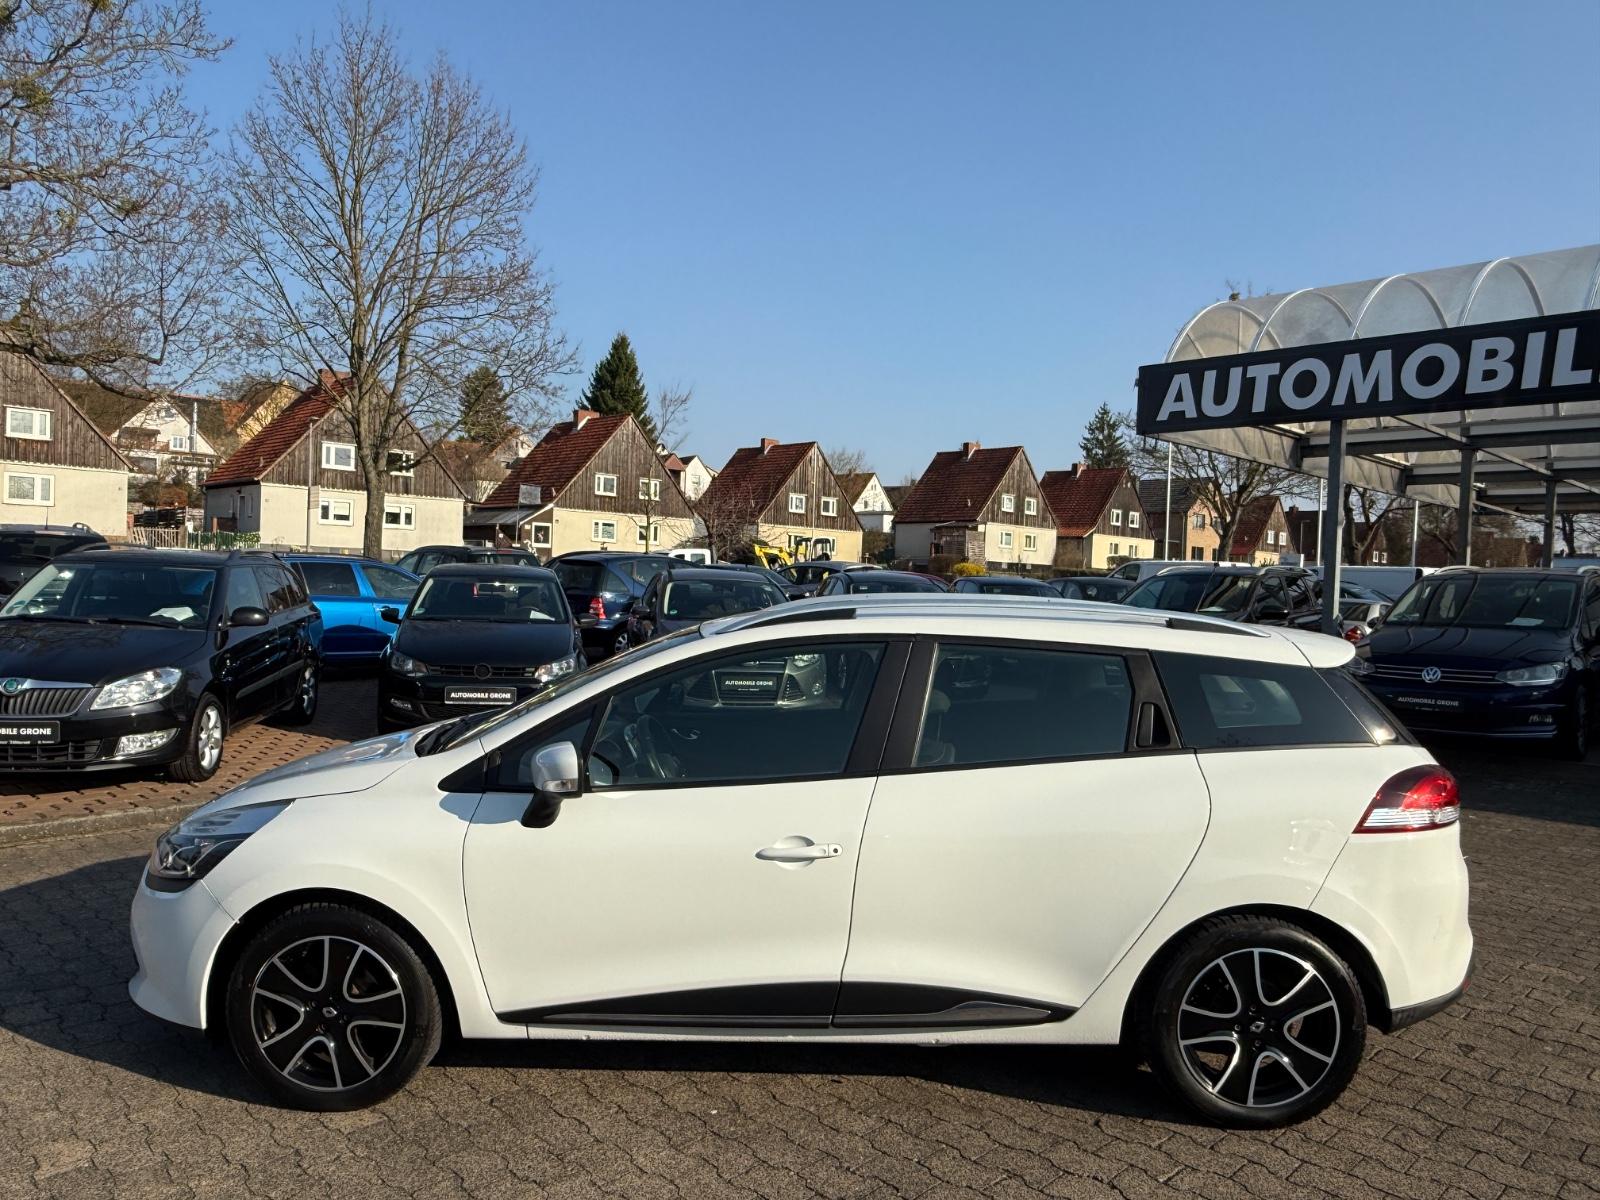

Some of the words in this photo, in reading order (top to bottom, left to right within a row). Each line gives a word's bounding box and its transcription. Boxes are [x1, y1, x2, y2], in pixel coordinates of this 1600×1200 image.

[1155, 327, 1600, 422] AUTOMOBIL
[0, 727, 18, 735] BILE
[19, 727, 52, 735] GRONE
